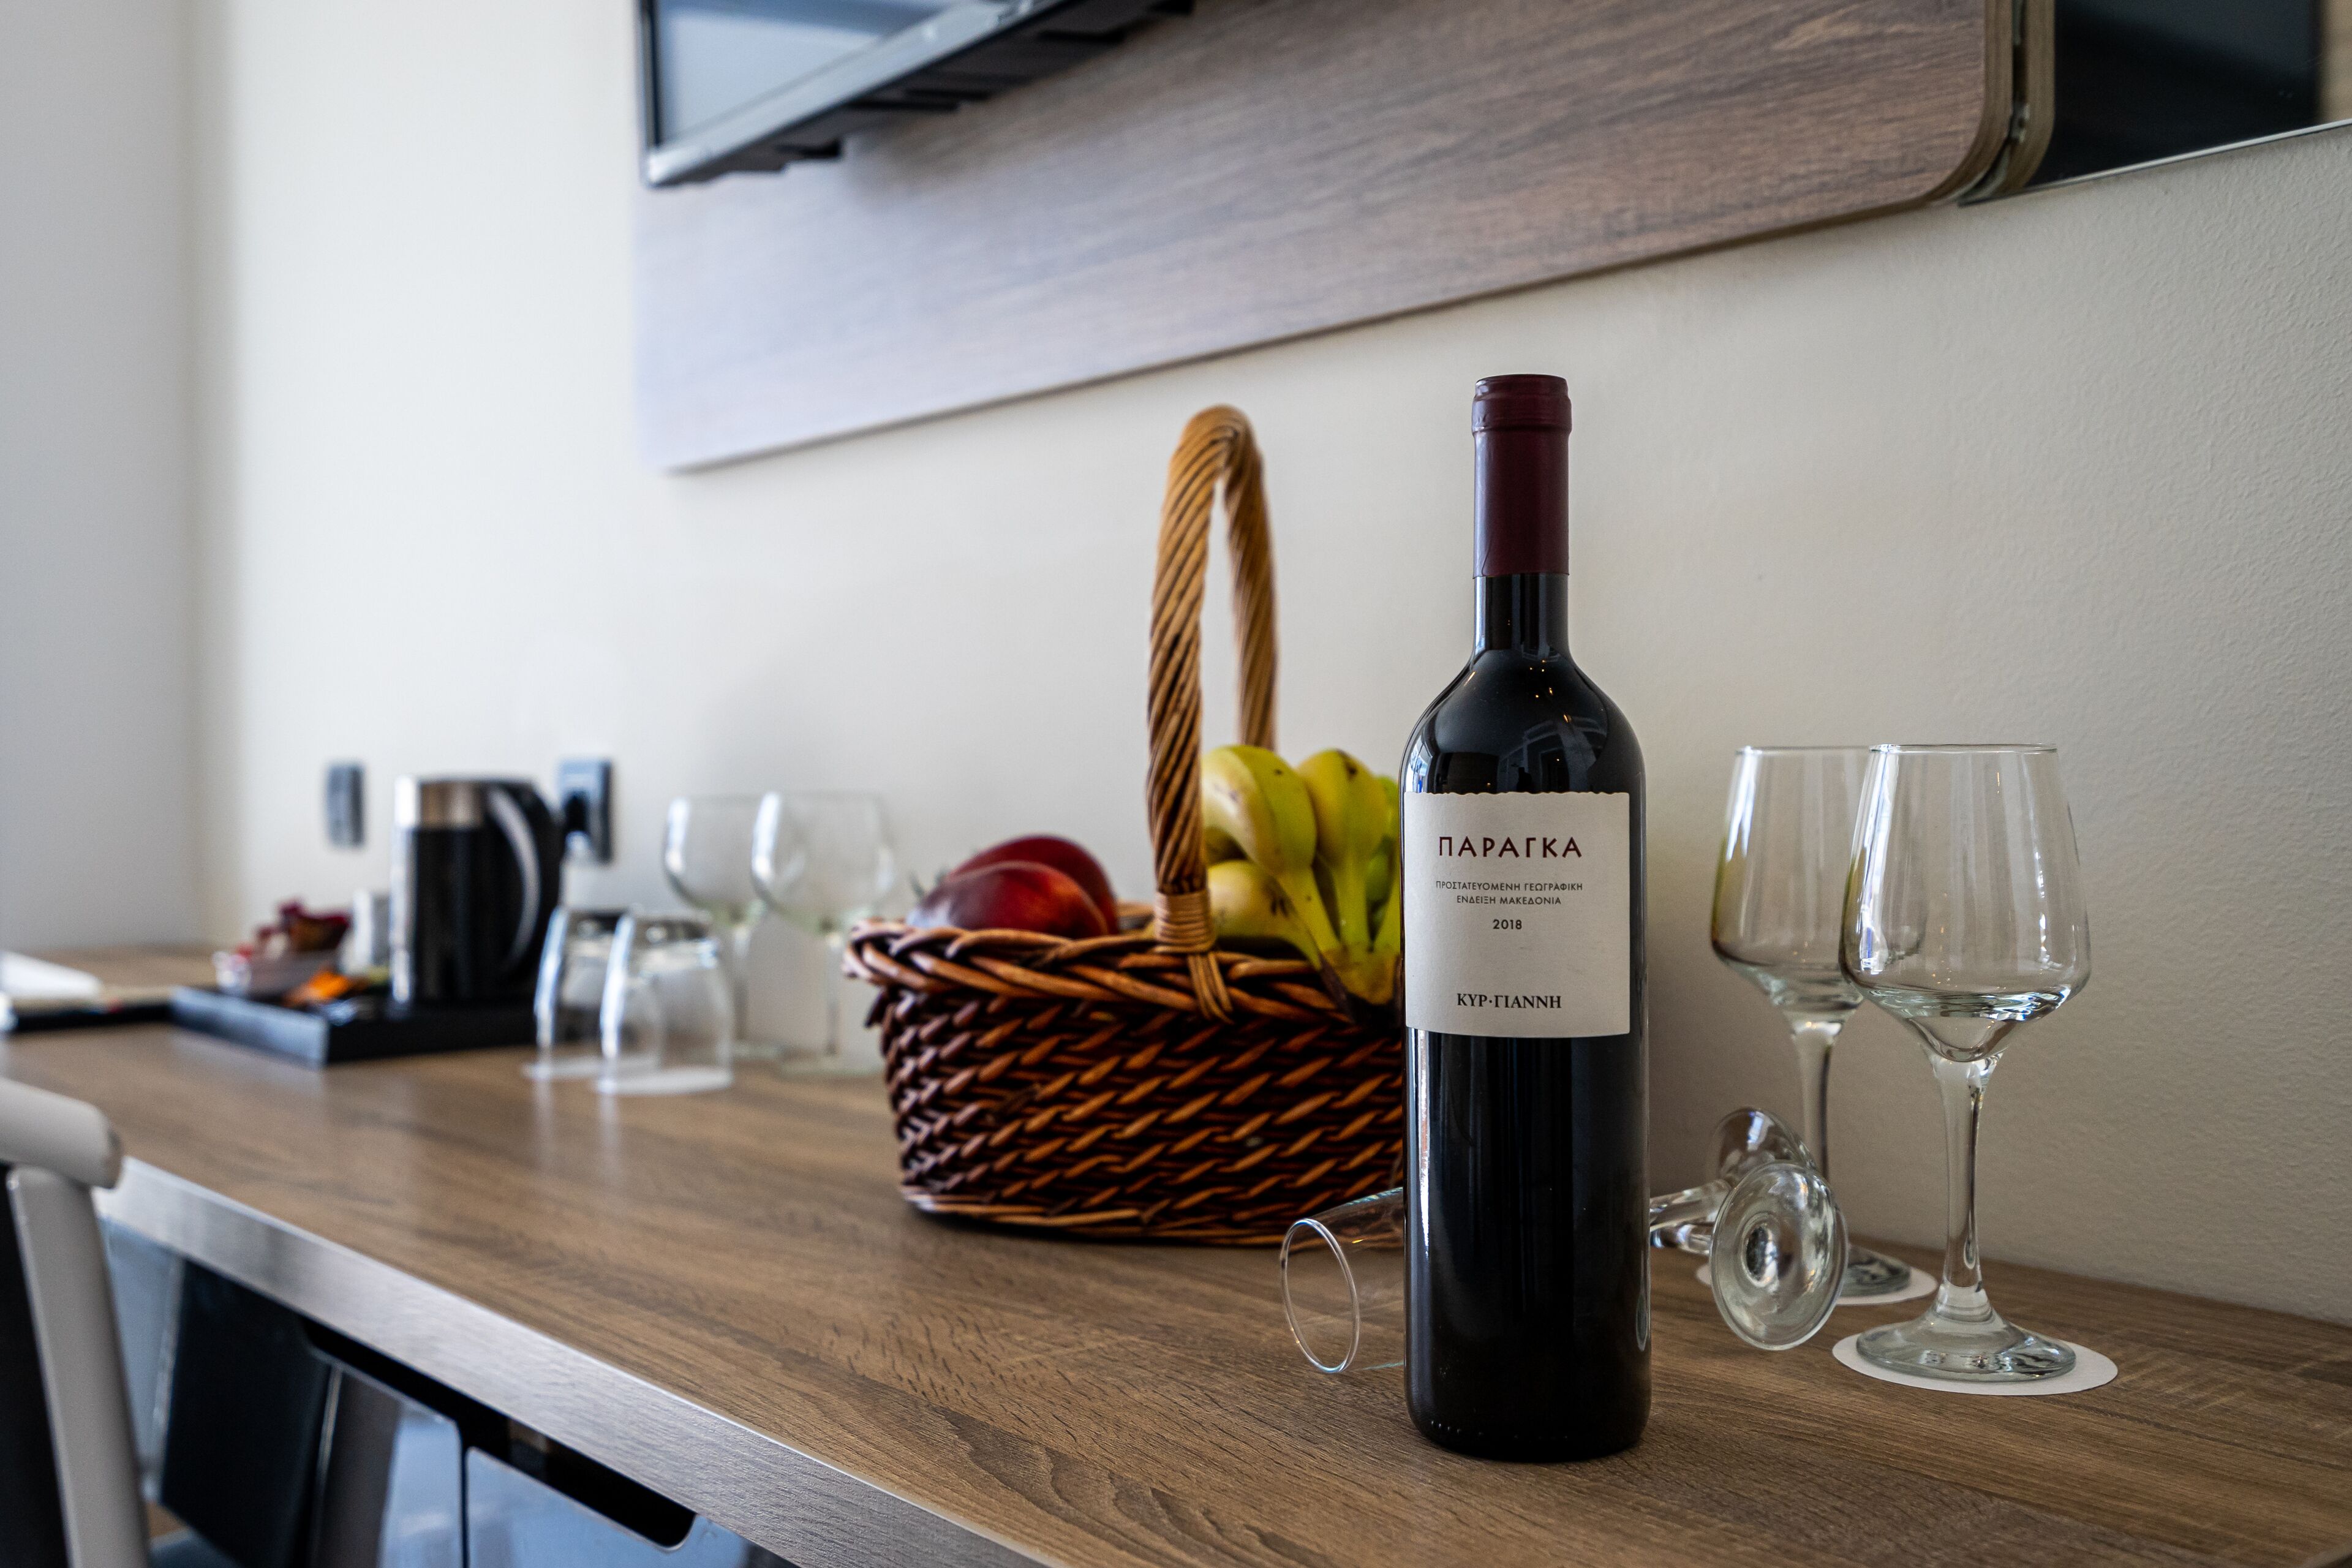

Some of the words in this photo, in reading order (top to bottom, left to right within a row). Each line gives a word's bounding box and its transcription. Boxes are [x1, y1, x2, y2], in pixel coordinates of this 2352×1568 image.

[1439, 835, 1582, 858] ΠΑΡΑΓΚΑ
[1436, 881, 1521, 891] ΠΡΟΣΤΑΤΕΥΟΜΕΝΗ
[1524, 883, 1583, 892] ΓΕΩΓΡΑΦΙΚΗ
[1457, 895, 1496, 905] ΕΝΔΕΙΞΗ
[1499, 896, 1561, 905] ΜΑΚΕΔΟΝΙΑ
[1493, 918, 1522, 930] 2018
